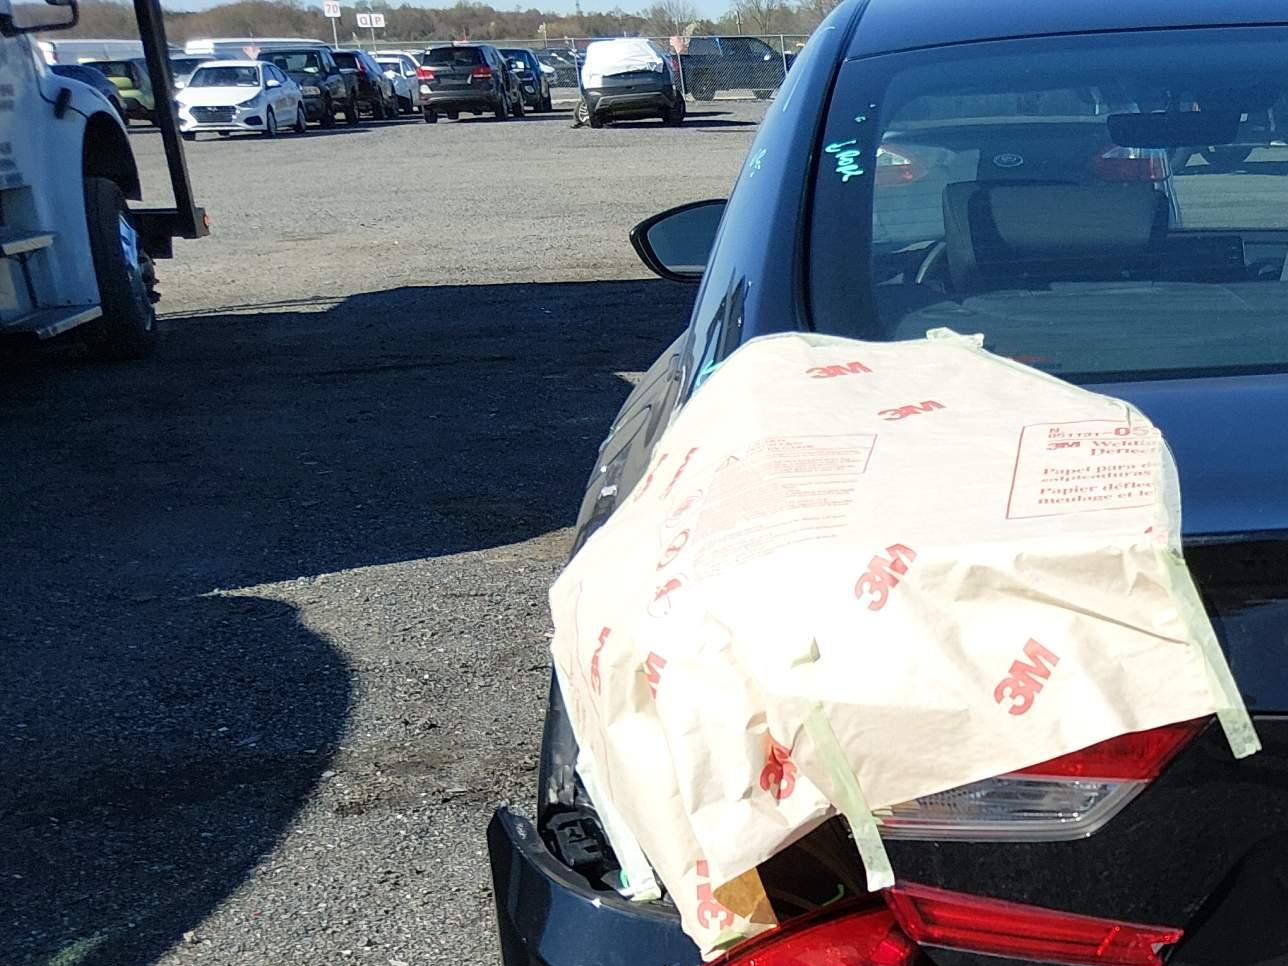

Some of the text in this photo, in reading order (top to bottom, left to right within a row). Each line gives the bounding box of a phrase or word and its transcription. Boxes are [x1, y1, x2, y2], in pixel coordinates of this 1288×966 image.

[326, 4, 338, 13] 70
[805, 361, 872, 379] 3M
[877, 400, 946, 421] 3M
[854, 543, 917, 611] 3M
[993, 638, 1060, 716] 3M
